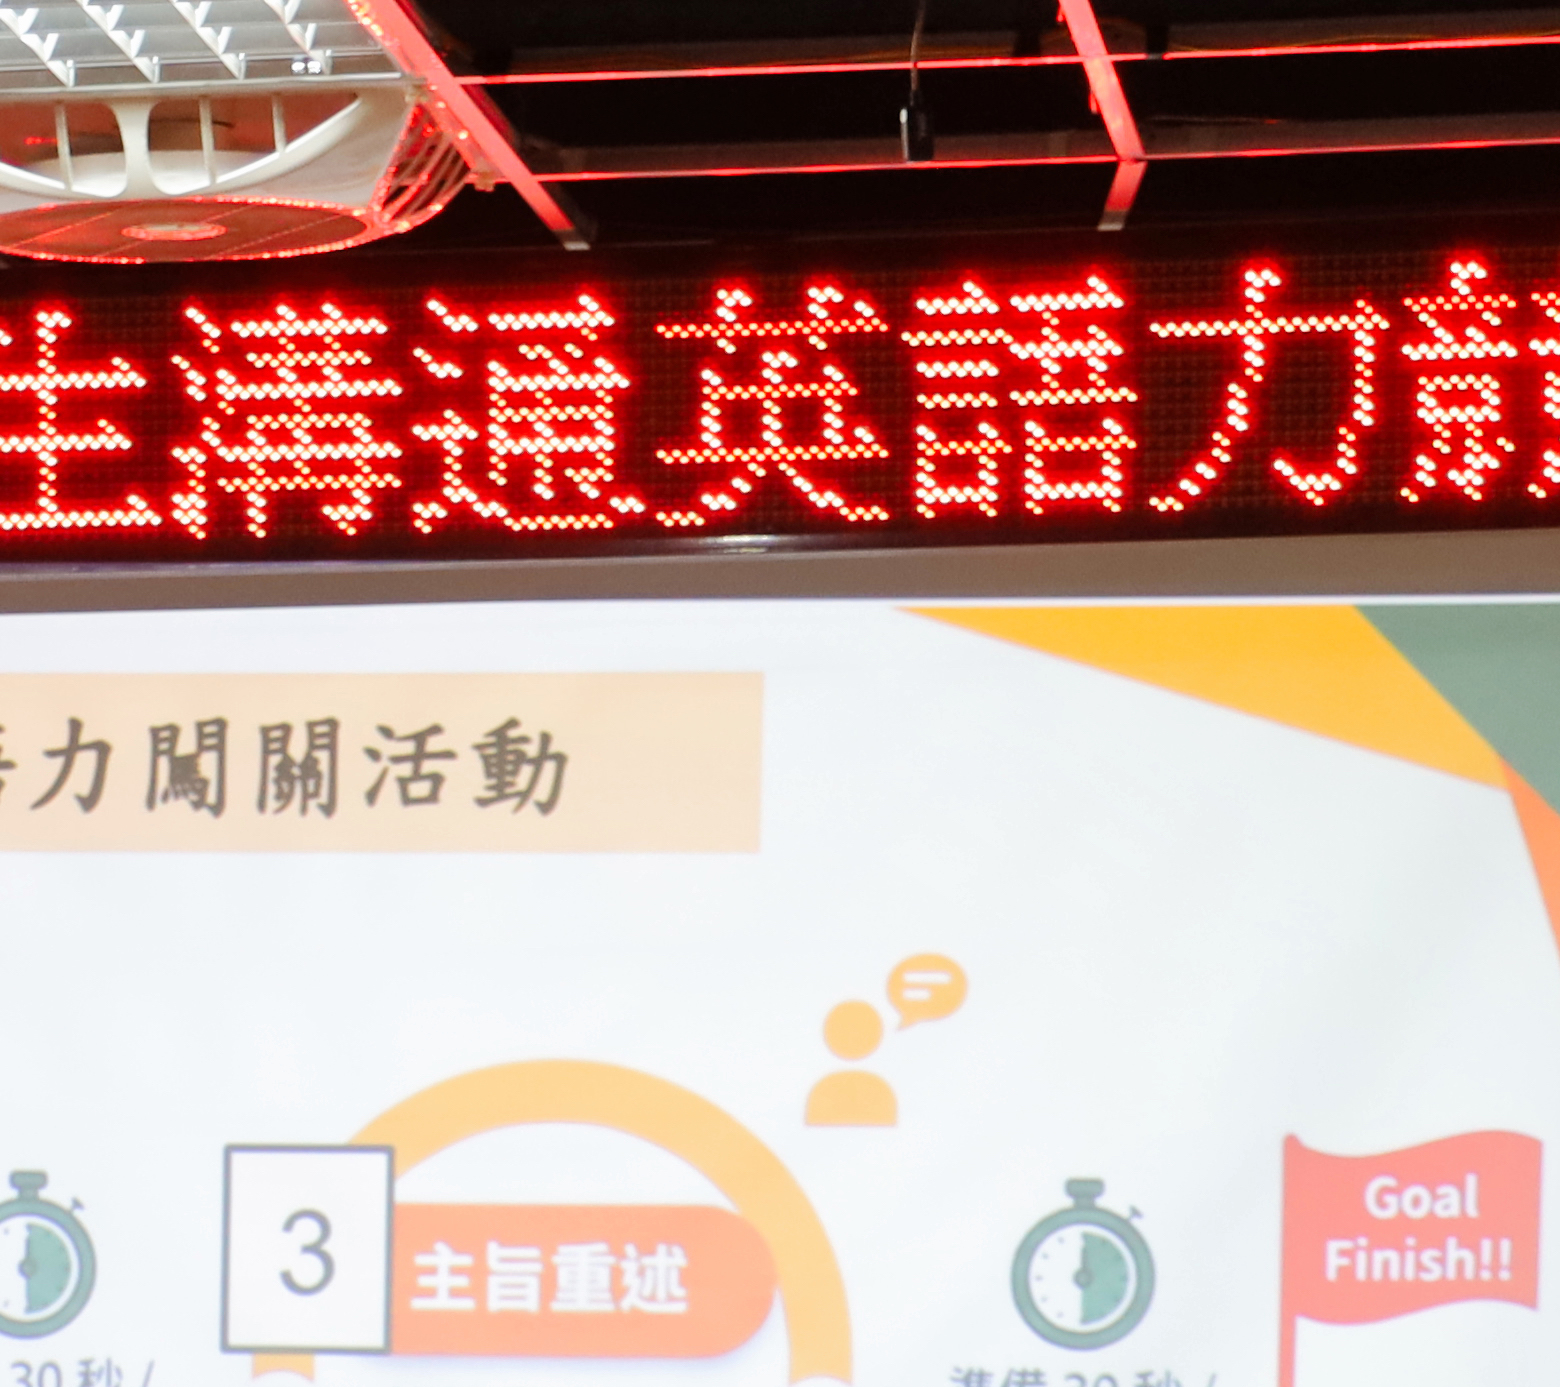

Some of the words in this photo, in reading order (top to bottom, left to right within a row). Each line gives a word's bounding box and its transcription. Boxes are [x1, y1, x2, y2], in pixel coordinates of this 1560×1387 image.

[1364, 1173, 1479, 1220] Goal
[279, 1207, 335, 1297] 3
[409, 1239, 690, 1314] 主旨重述
[1325, 1236, 1512, 1283] Finish!!
